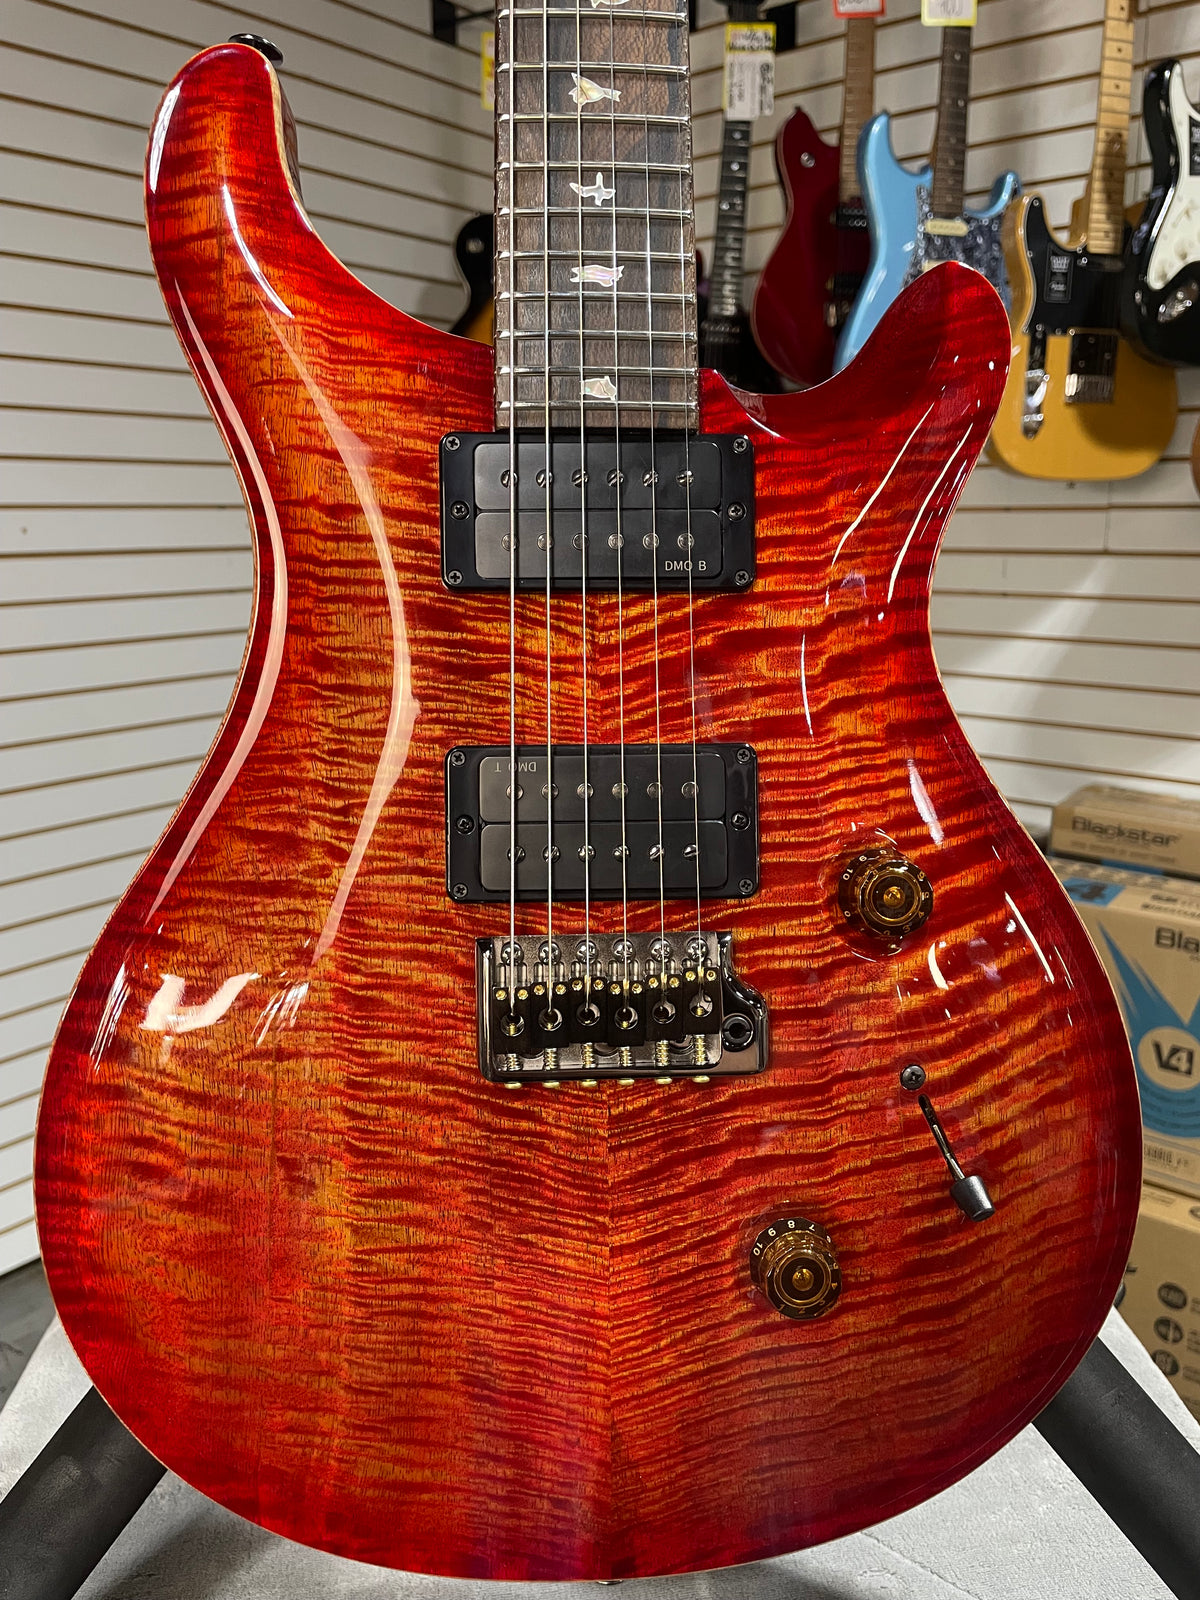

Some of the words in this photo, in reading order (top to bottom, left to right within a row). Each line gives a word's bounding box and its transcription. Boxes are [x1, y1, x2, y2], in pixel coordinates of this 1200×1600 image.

[665, 561, 693, 571] DMO
[698, 561, 707, 571] B
[494, 761, 502, 773] T
[1071, 815, 1179, 847] Blackstar
[842, 868, 854, 881] 10
[1151, 1039, 1194, 1076] V4
[753, 1242, 763, 1256] 10
[768, 1227, 777, 1237] 9
[787, 1220, 796, 1229] 8
